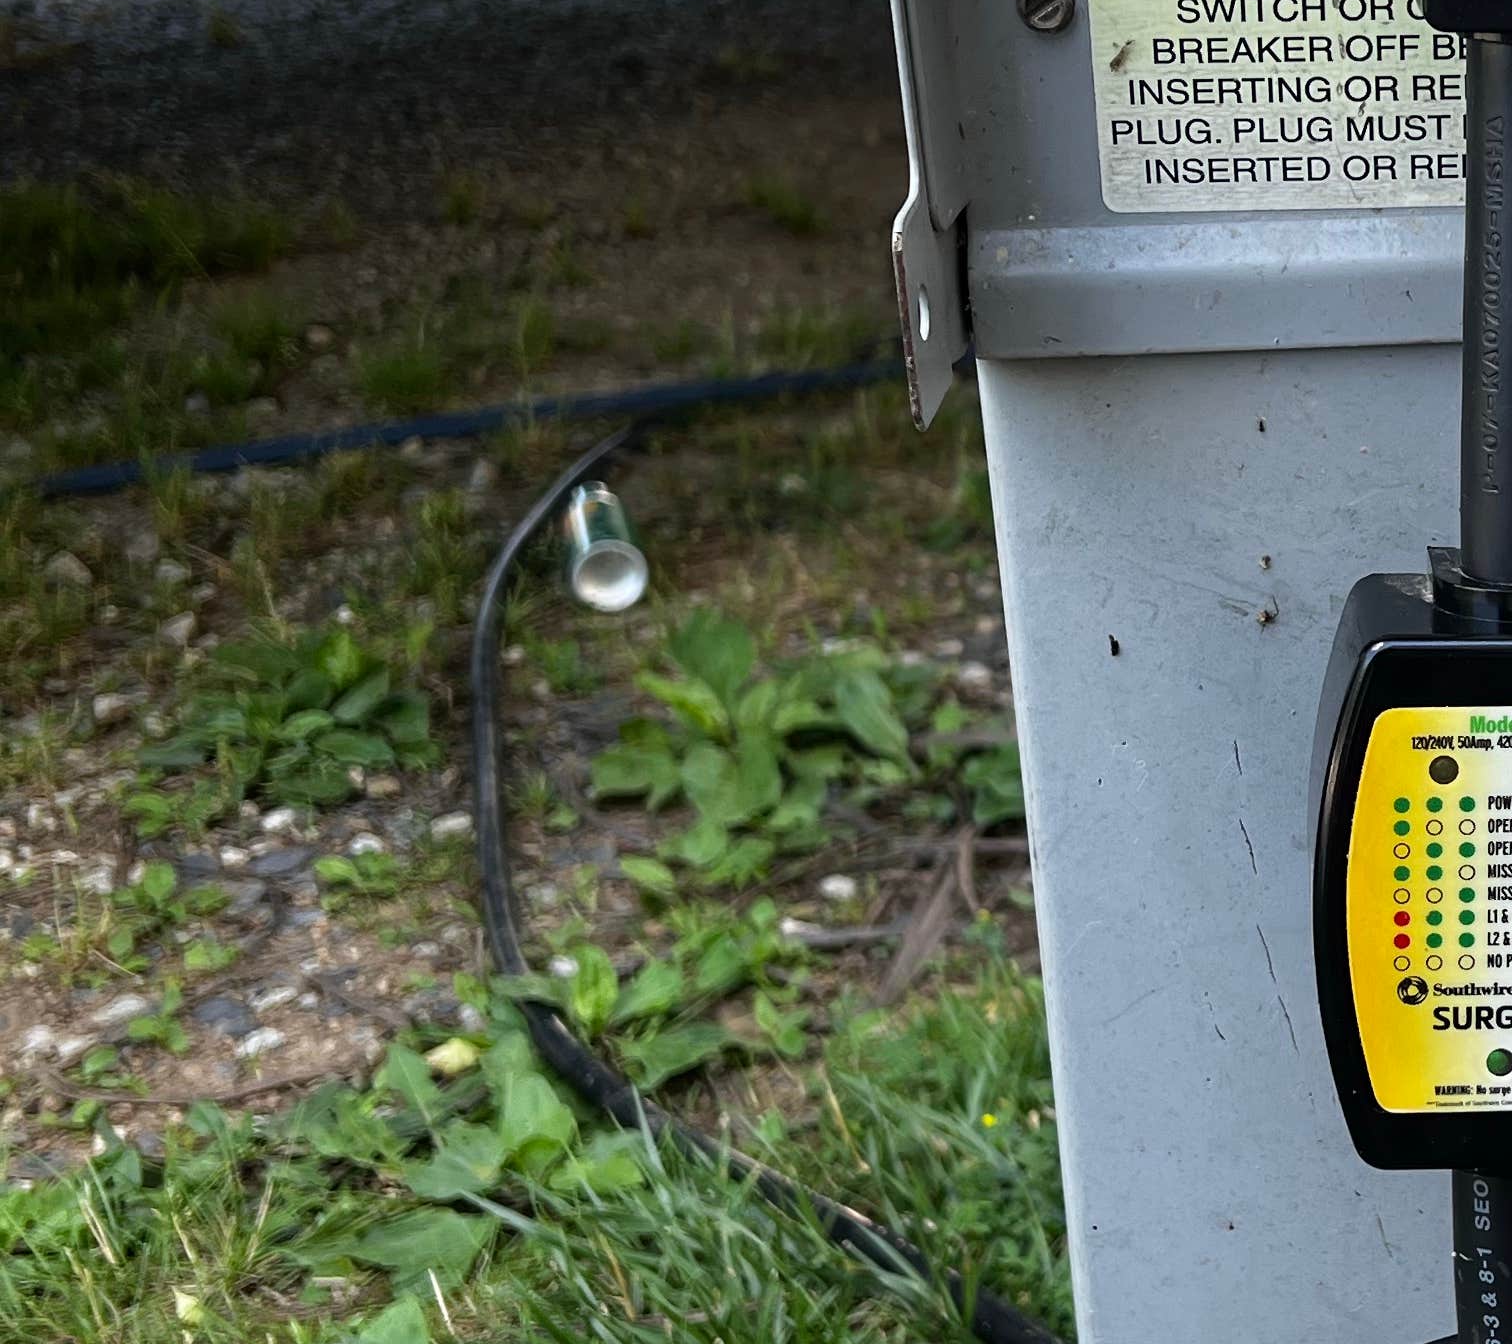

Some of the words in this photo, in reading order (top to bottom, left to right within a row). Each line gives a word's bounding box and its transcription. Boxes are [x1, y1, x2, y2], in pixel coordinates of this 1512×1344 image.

[1152, 36, 1334, 65] BREAKER
[1345, 34, 1420, 63] OFF
[1128, 76, 1332, 106] INSERTING
[1344, 74, 1399, 103] OR
[1111, 118, 1222, 145] PLUG.
[1233, 115, 1333, 144] PLUG
[1346, 113, 1453, 142] MUST
[1145, 156, 1331, 185] INSERTED
[1343, 154, 1398, 182] OR
[1487, 908, 1498, 924] L1
[1501, 908, 1509, 924] &
[1487, 931, 1500, 946] L2
[1503, 931, 1511, 946] &
[1487, 953, 1503, 969] NO
[1434, 1085, 1474, 1096] WARNING:
[1476, 1085, 1487, 1095] No
[1488, 1086, 1511, 1097] surge
[1472, 1179, 1492, 1231] SEO
[1476, 1247, 1495, 1285] 8-1
[1480, 1292, 1498, 1308] &
